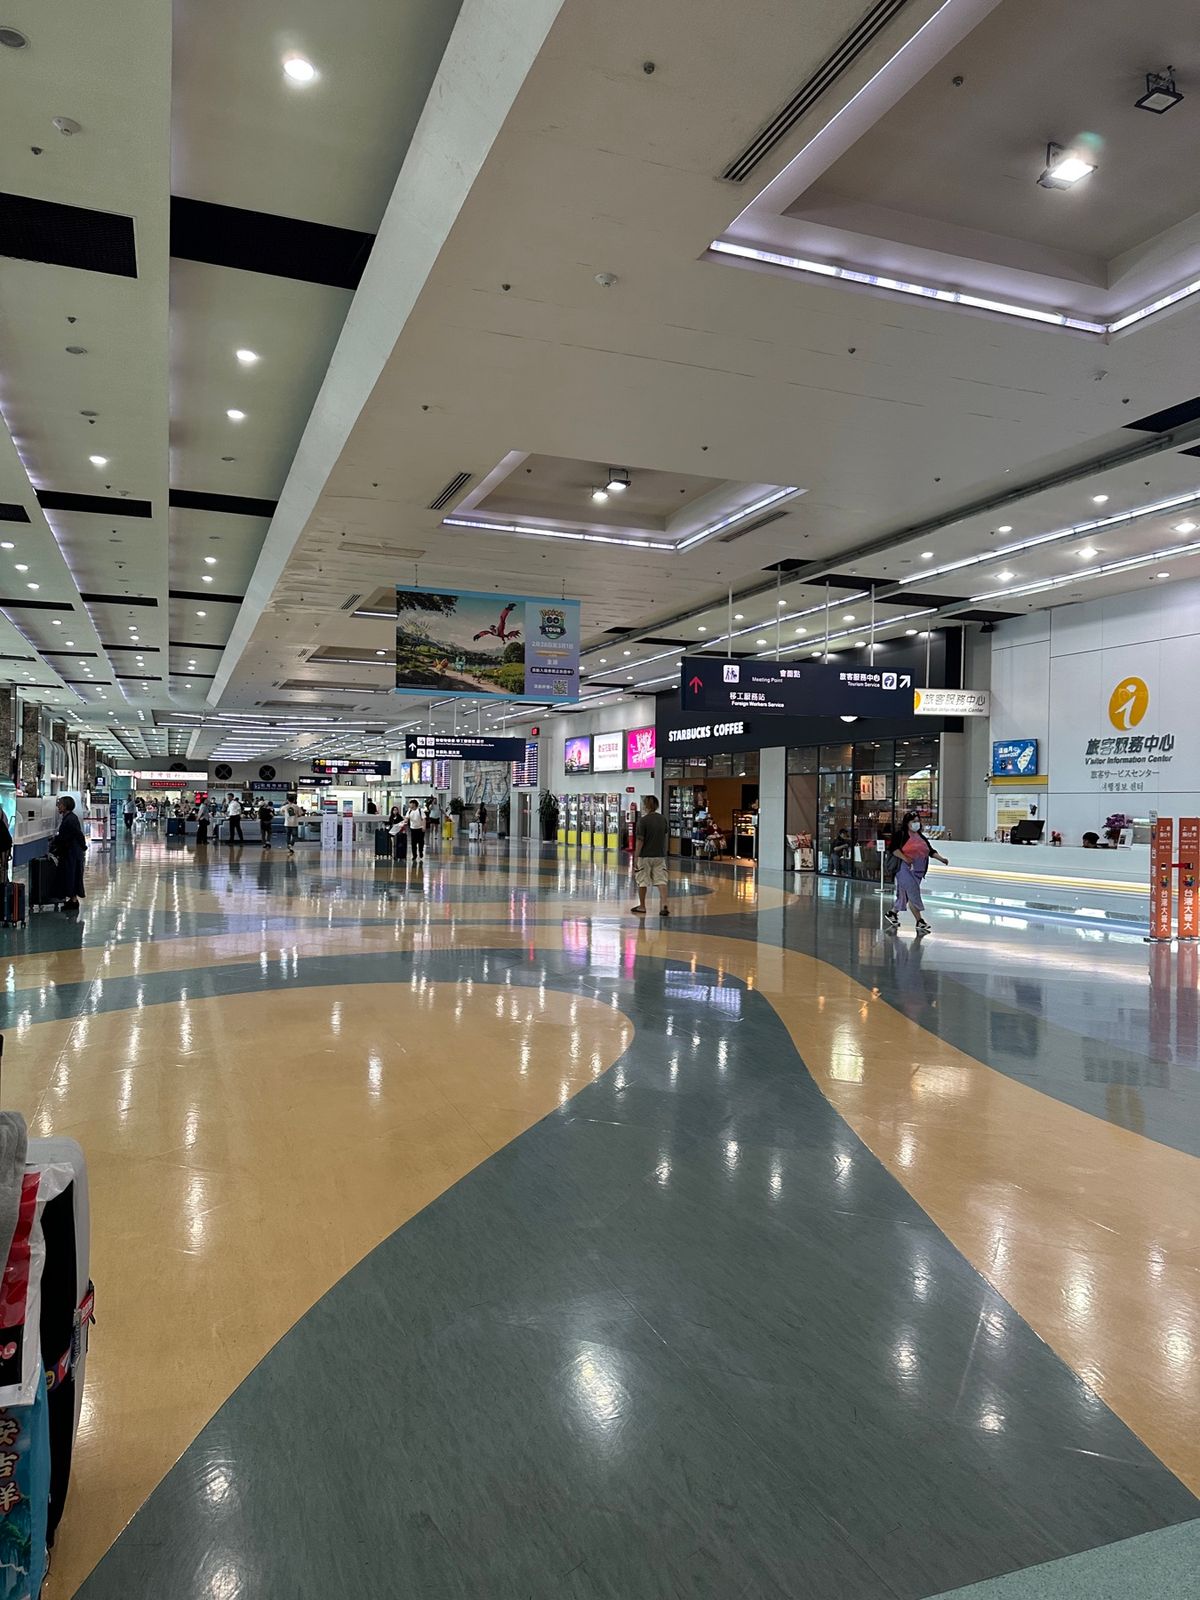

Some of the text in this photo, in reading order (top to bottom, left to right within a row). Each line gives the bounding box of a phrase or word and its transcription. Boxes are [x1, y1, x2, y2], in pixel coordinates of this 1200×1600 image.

[839, 673, 881, 682] 旅客服務中心
[729, 692, 766, 701] 移工服務站
[924, 694, 985, 706] 旅客服務中心
[668, 721, 744, 742] STARBUCKS COFFEE
[1085, 734, 1175, 756] 旅客服務中心
[1085, 755, 1173, 765] Vsitor Information Center
[1184, 889, 1193, 931] 台灣大哥大
